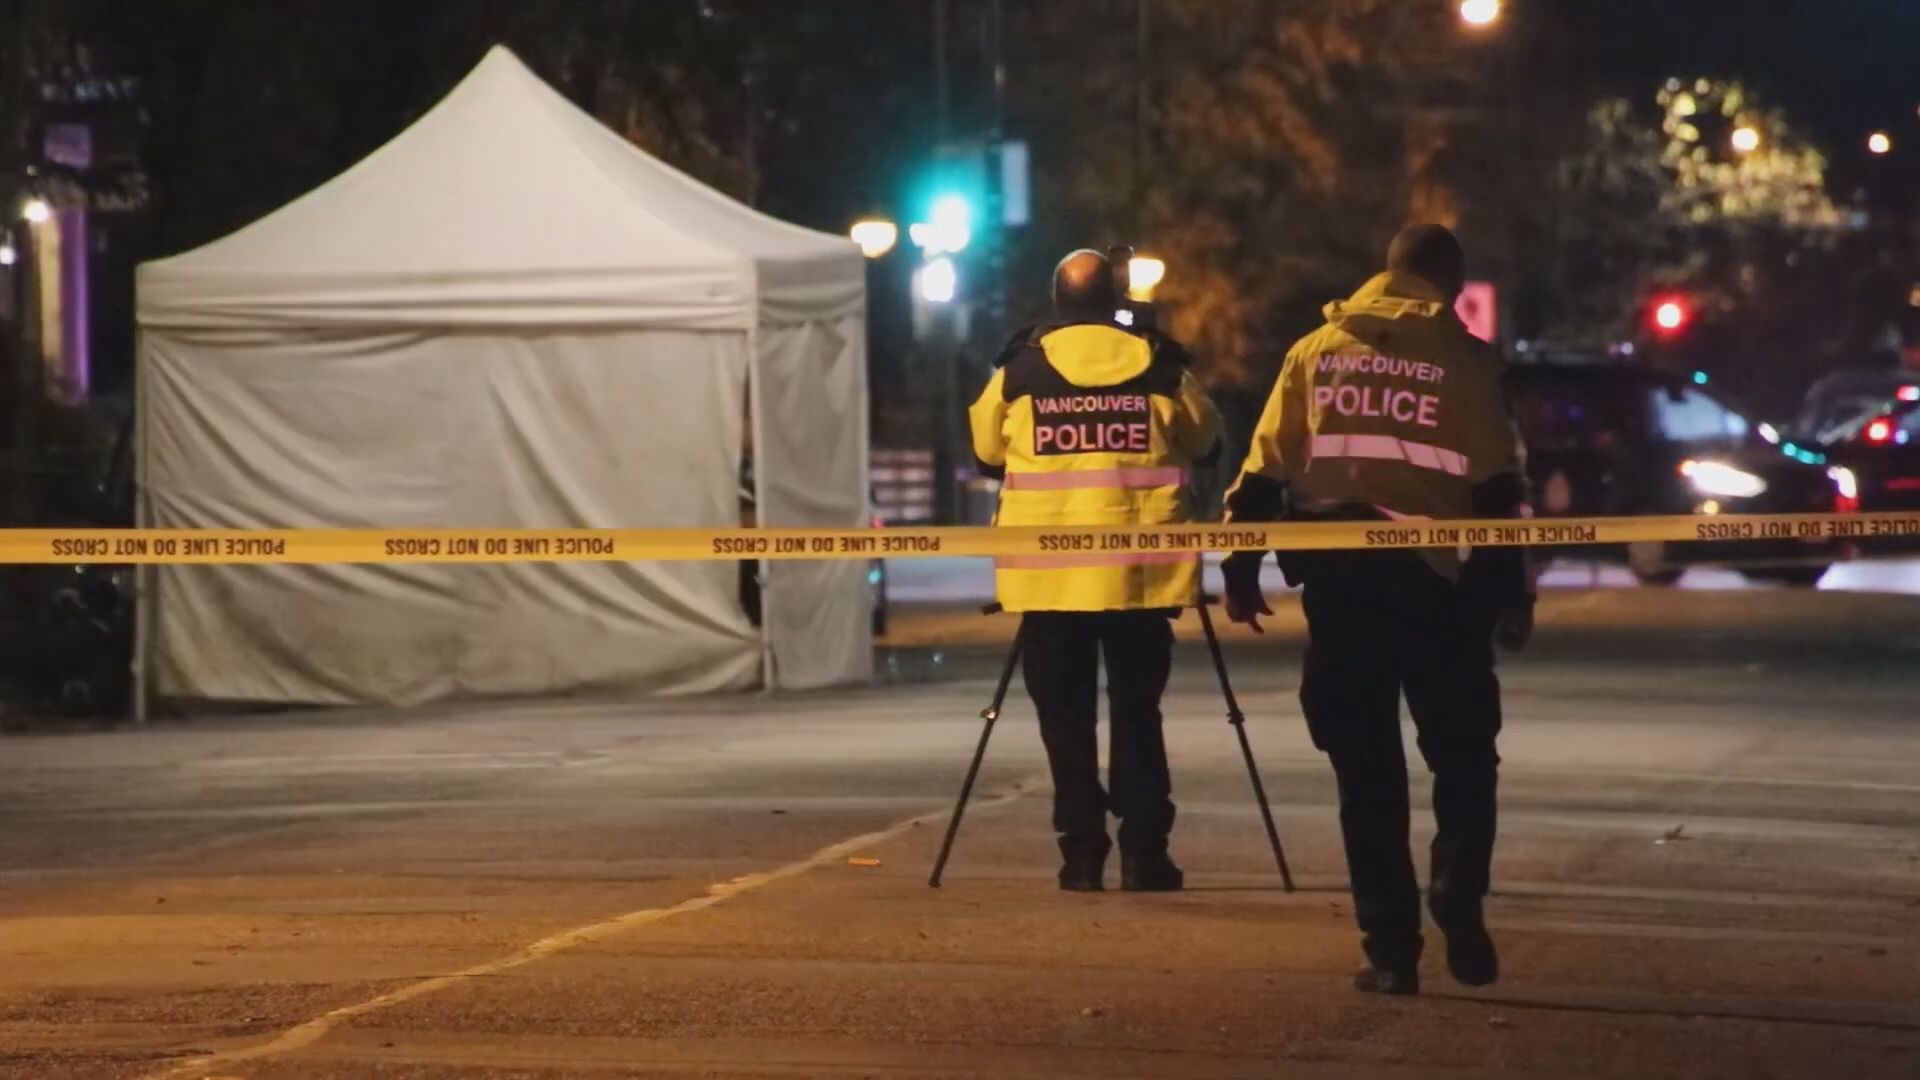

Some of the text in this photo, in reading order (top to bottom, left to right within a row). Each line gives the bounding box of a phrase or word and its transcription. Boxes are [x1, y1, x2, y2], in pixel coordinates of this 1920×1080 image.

[1317, 353, 1446, 384] VANCOUVER
[1035, 395, 1147, 414] VANCOUVER
[1314, 385, 1440, 427] POLICE
[1036, 424, 1147, 452] POLICE
[1365, 525, 1596, 546] POLICE LINE DO NOT CROSS
[1696, 519, 1920, 539] OLICE LINE DO NOT CROSS
[52, 538, 286, 556] POLICE LINE DO NOT CROSS
[384, 537, 614, 555] POLICE LINE DO NOT CROSS
[712, 536, 941, 553] POLICE LINE DO NOT CROSS
[1038, 531, 1267, 551] POLICE LINE DO NOT CROSS
